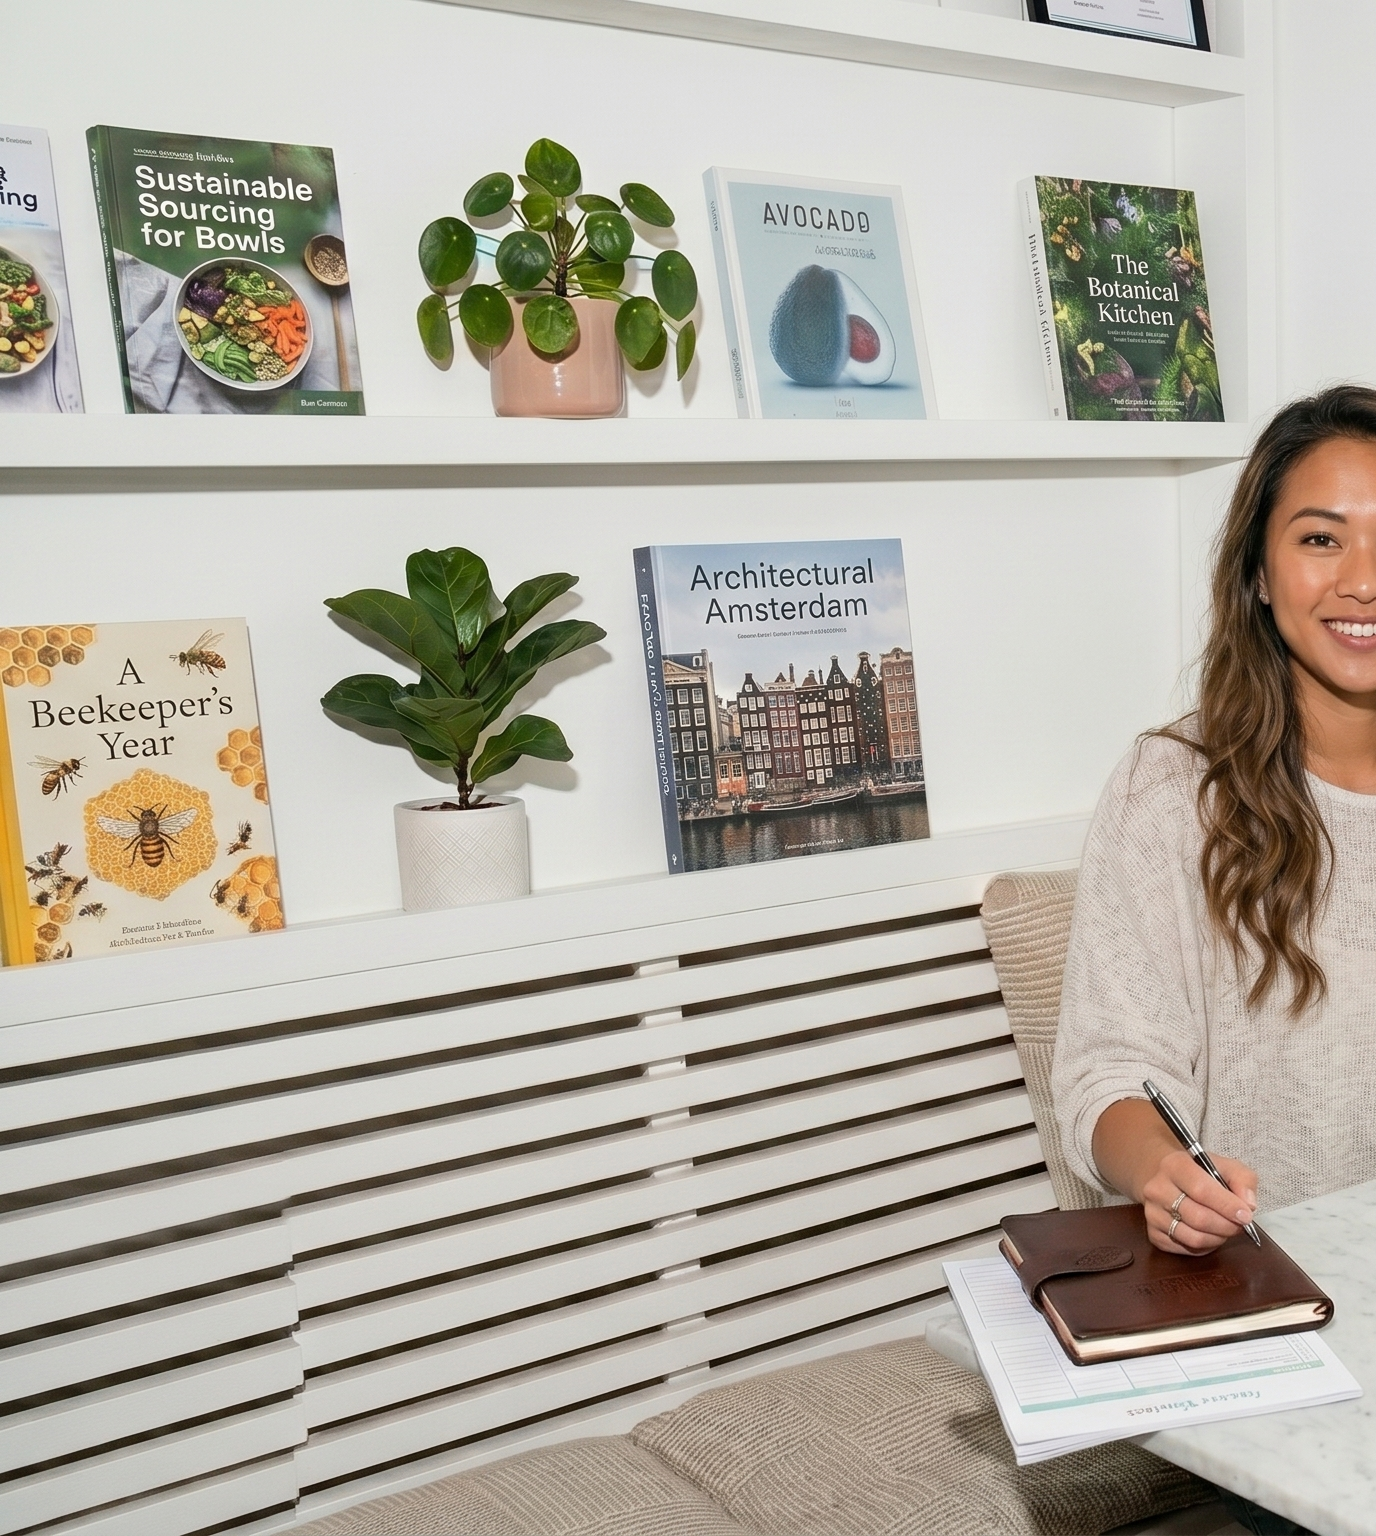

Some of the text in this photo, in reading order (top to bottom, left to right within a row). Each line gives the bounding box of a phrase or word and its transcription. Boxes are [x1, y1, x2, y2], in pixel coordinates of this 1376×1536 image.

[135, 165, 313, 202] Sustainable
[138, 192, 275, 231] Sourcing
[140, 222, 286, 254] for Bowls
[1111, 253, 1149, 276] The
[1086, 276, 1180, 302] Botanical
[1097, 302, 1175, 326] Kitchen
[690, 557, 874, 591] Architectural
[705, 592, 868, 625] Amsterdam
[116, 657, 145, 686] A
[28, 686, 233, 729] Beekeeper's
[97, 731, 175, 761] Year
